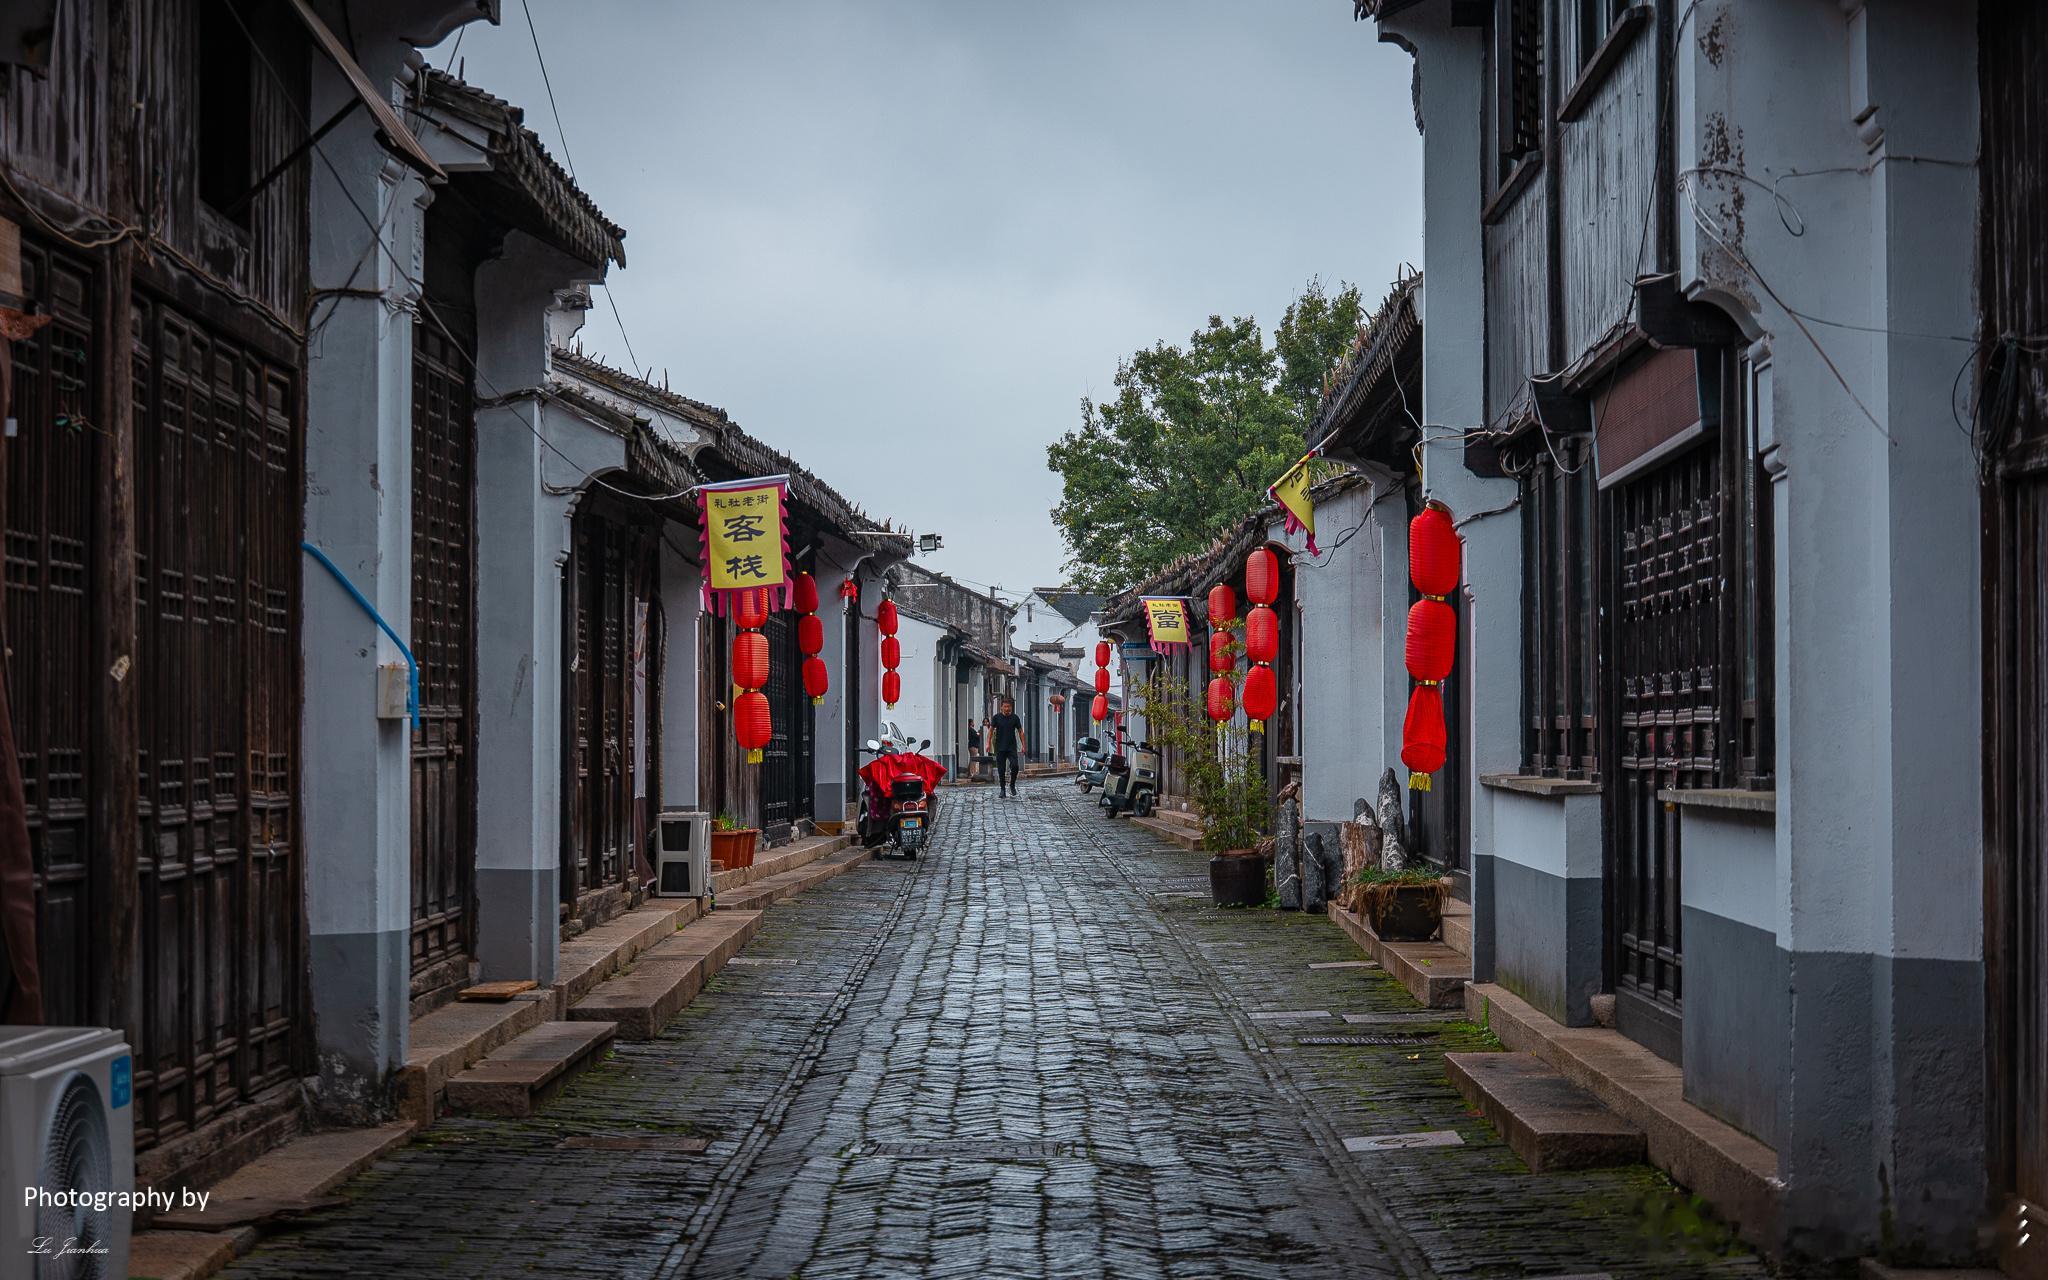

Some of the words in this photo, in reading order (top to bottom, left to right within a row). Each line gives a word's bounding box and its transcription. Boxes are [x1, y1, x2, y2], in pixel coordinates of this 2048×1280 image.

[714, 494, 769, 509] 礼社老街
[722, 514, 768, 580] 客栈
